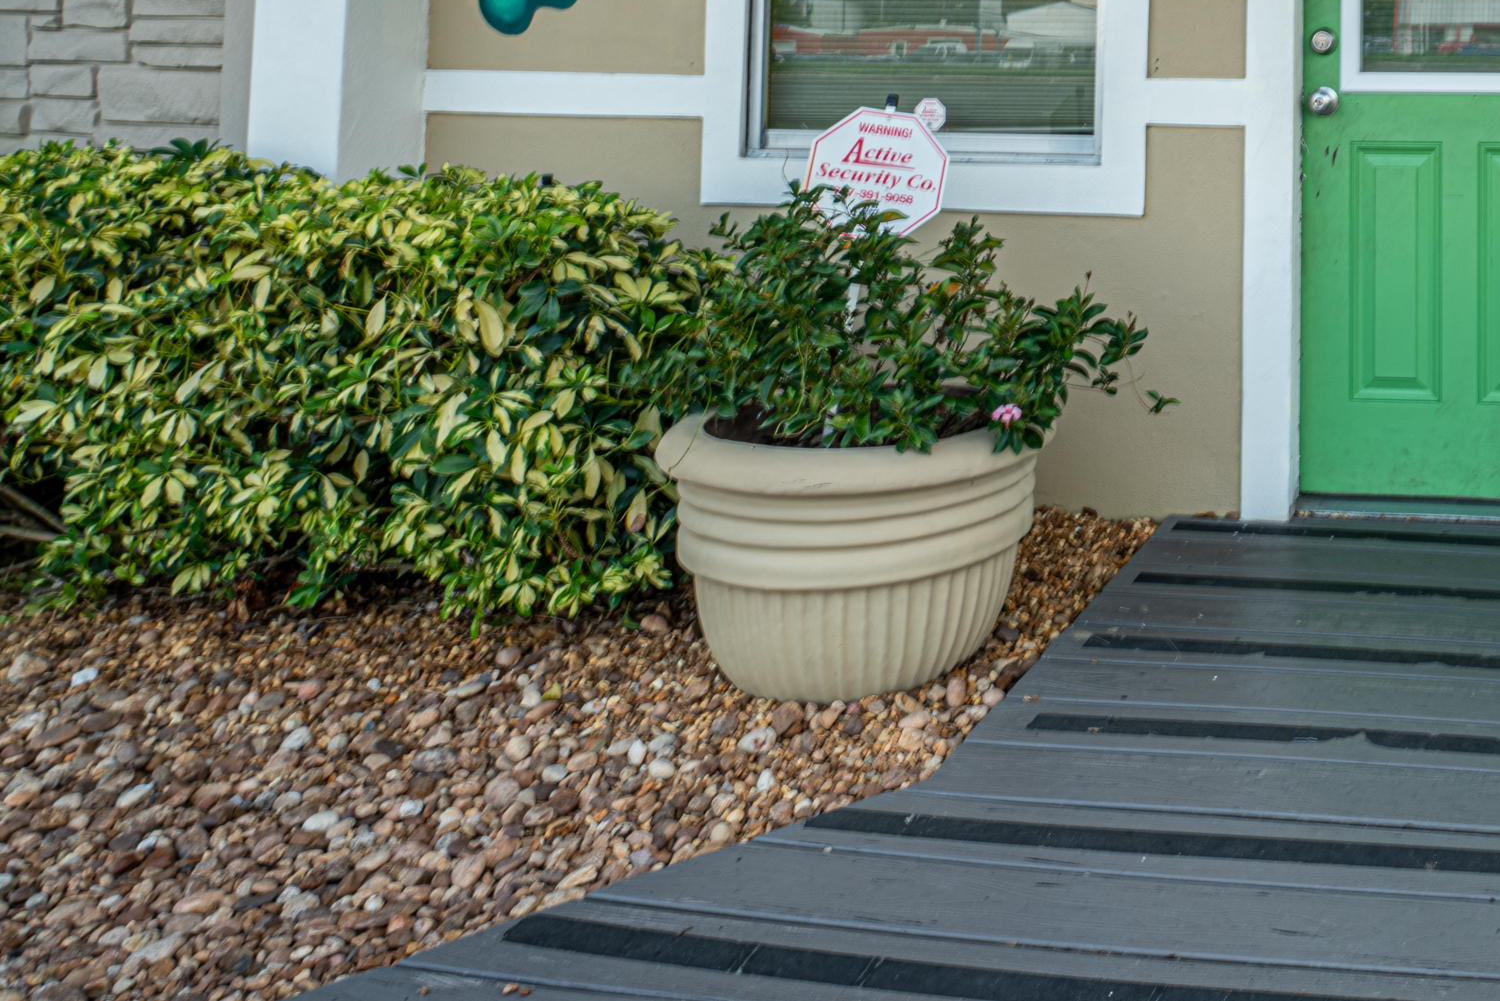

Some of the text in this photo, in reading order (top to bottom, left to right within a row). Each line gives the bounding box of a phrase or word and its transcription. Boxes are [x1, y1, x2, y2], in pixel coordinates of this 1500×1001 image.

[858, 121, 914, 139] WARNING!
[841, 136, 914, 165] Active
[815, 162, 903, 190] Security
